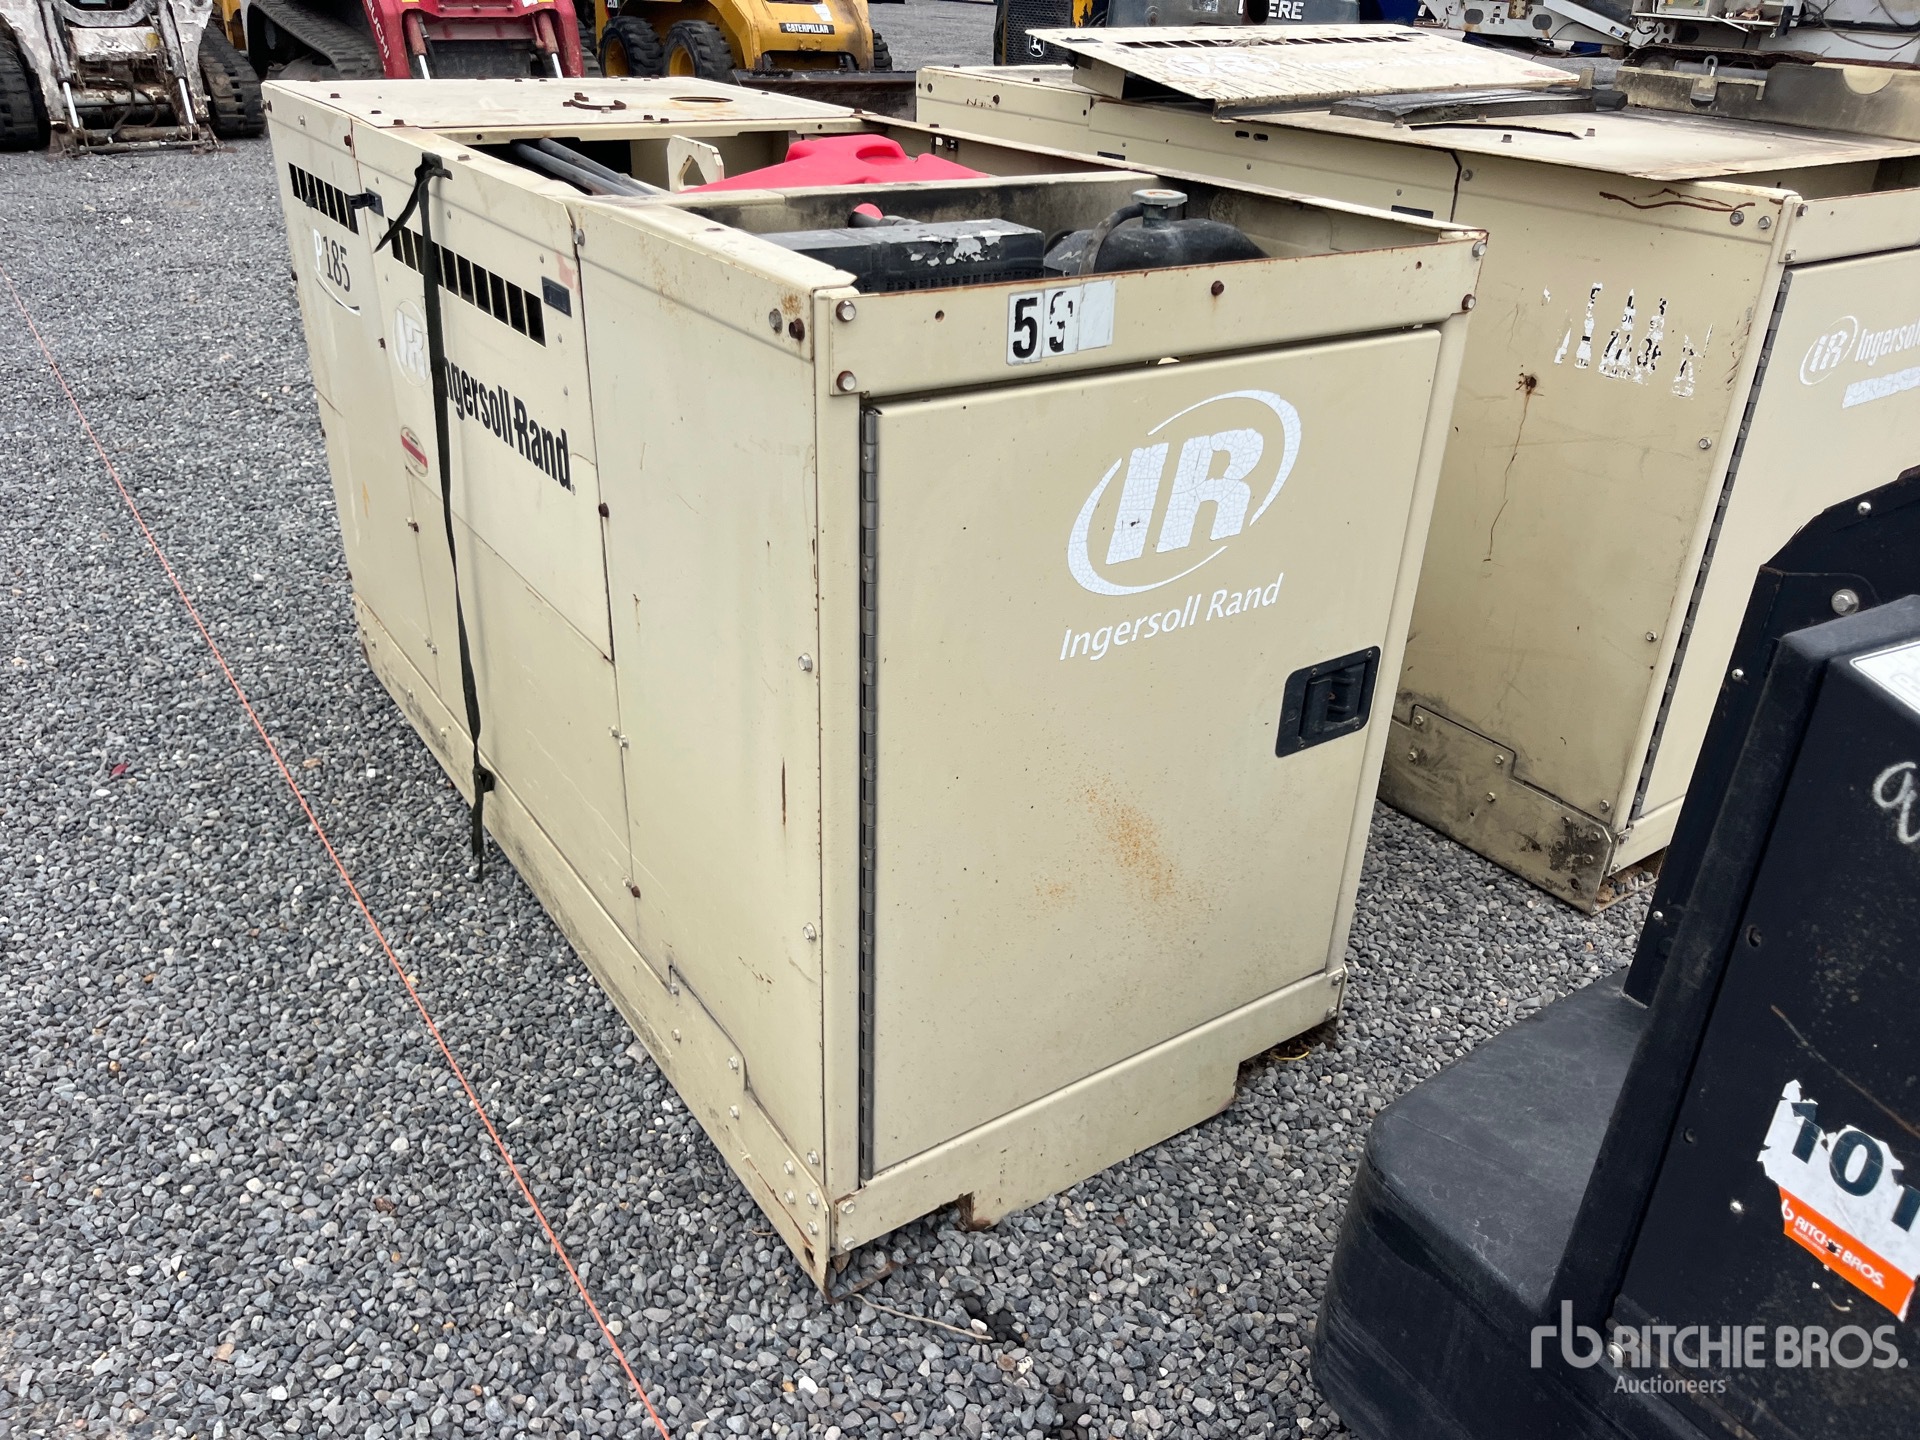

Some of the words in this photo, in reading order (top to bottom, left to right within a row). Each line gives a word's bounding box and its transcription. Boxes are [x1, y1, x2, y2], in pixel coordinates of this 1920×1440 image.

[785, 23, 830, 34] CATERPILLAR
[1808, 330, 1849, 373] IR
[1105, 427, 1264, 566] IR
[1059, 593, 1201, 661] Ingersoll
[1205, 571, 1285, 622] Rand
